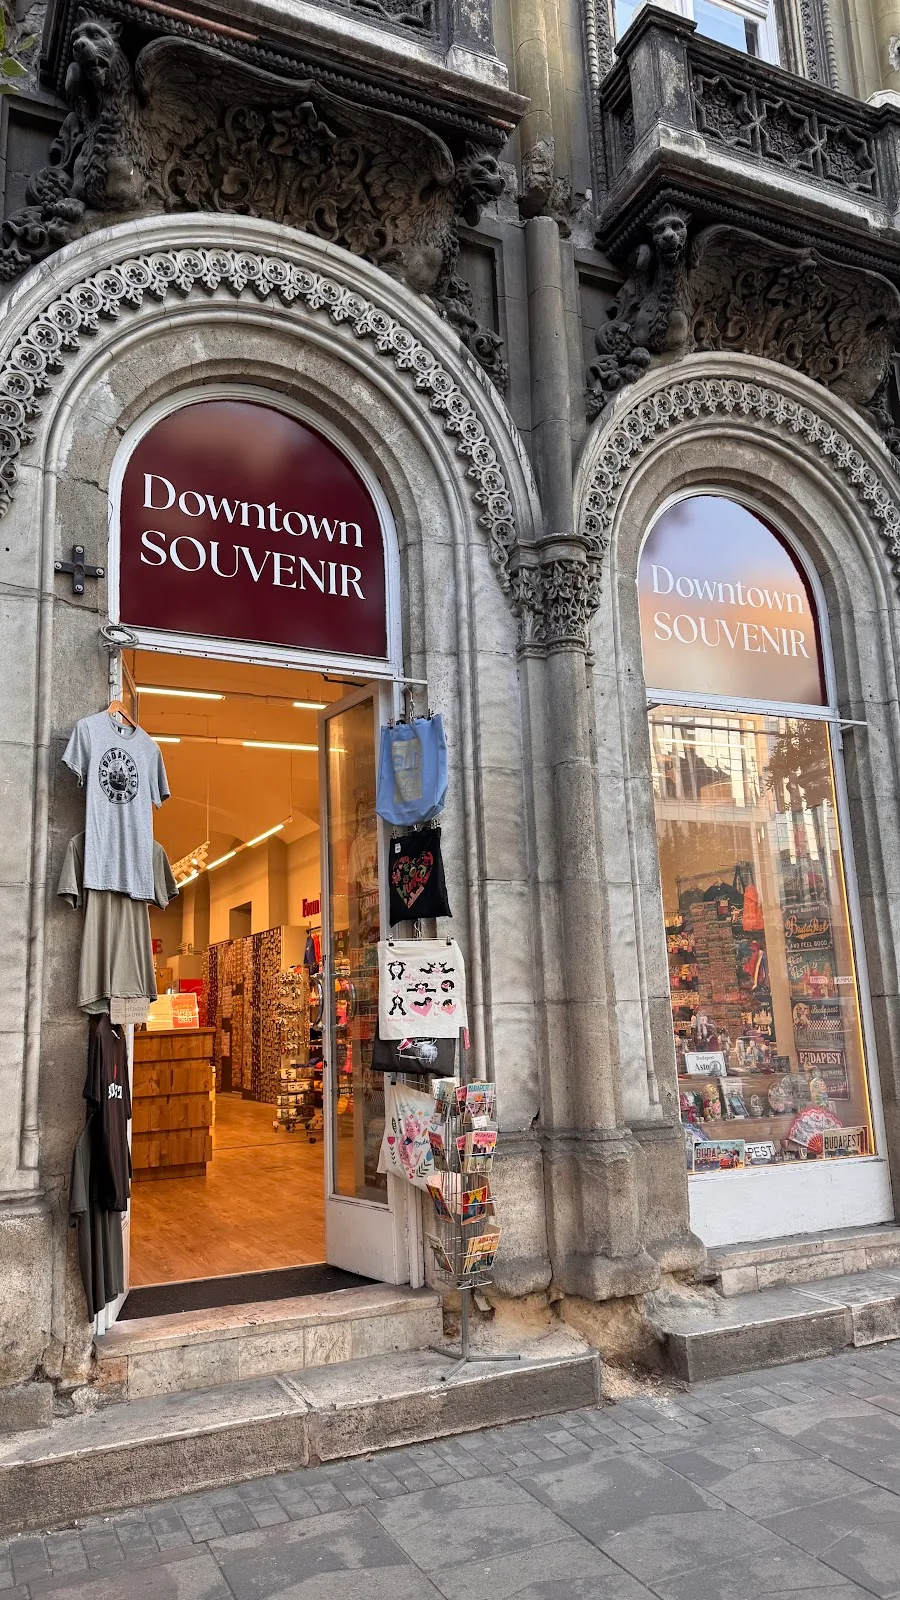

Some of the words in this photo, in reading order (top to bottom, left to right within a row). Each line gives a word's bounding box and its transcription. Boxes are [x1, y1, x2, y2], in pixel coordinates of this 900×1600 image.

[142, 473, 364, 548] Downtown
[140, 530, 367, 600] SOUVENIR
[651, 564, 804, 615] Downtown
[653, 611, 811, 659] SOUVENIR
[695, 1063, 710, 1071] Asto
[800, 1052, 842, 1065] BUDAPEST
[696, 1147, 717, 1158] BUDA
[824, 1134, 861, 1150] BUDAPEST
